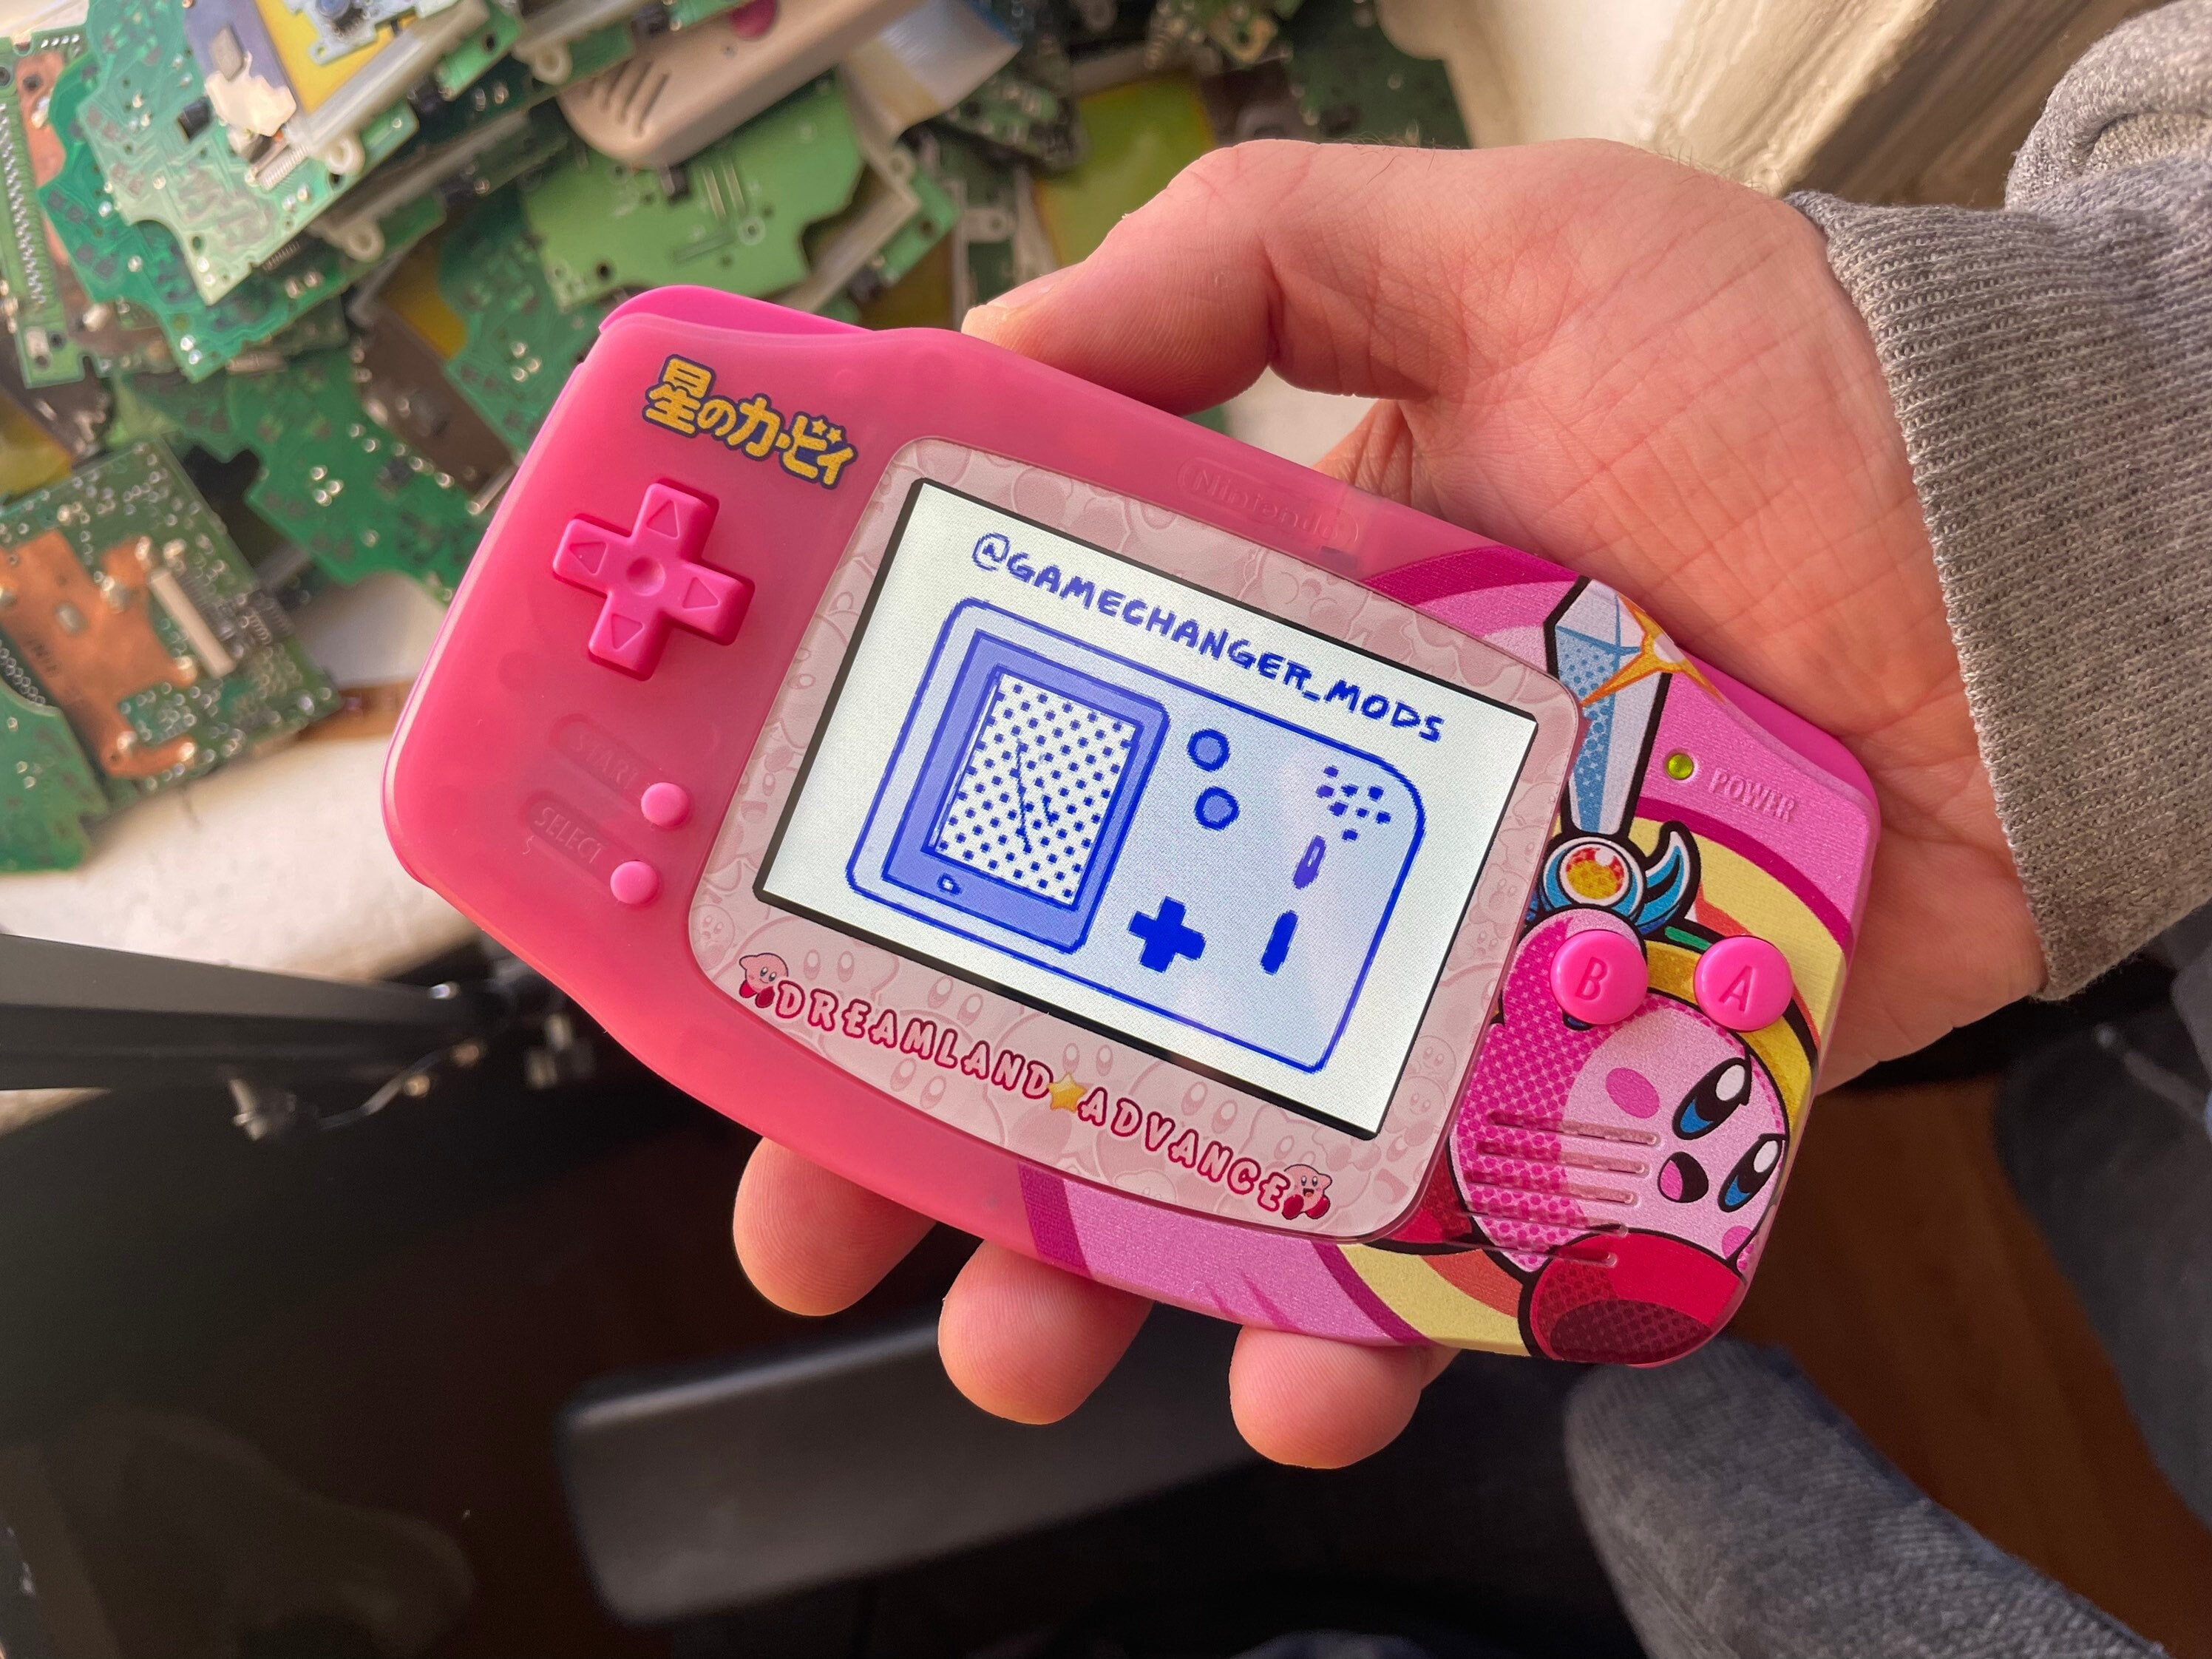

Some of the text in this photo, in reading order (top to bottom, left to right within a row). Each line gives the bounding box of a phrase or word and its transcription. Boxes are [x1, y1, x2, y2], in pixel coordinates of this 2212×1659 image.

[1192, 468, 1340, 541] Nintendo
[972, 533, 1447, 743] @GAMECHANGER_MODS
[1709, 768, 1797, 823] POWER
[534, 807, 609, 864] SELECT
[1575, 956, 1609, 1001] B
[1718, 965, 1755, 1013] A
[773, 979, 1291, 1213] DREAMLAND ADVANCE
